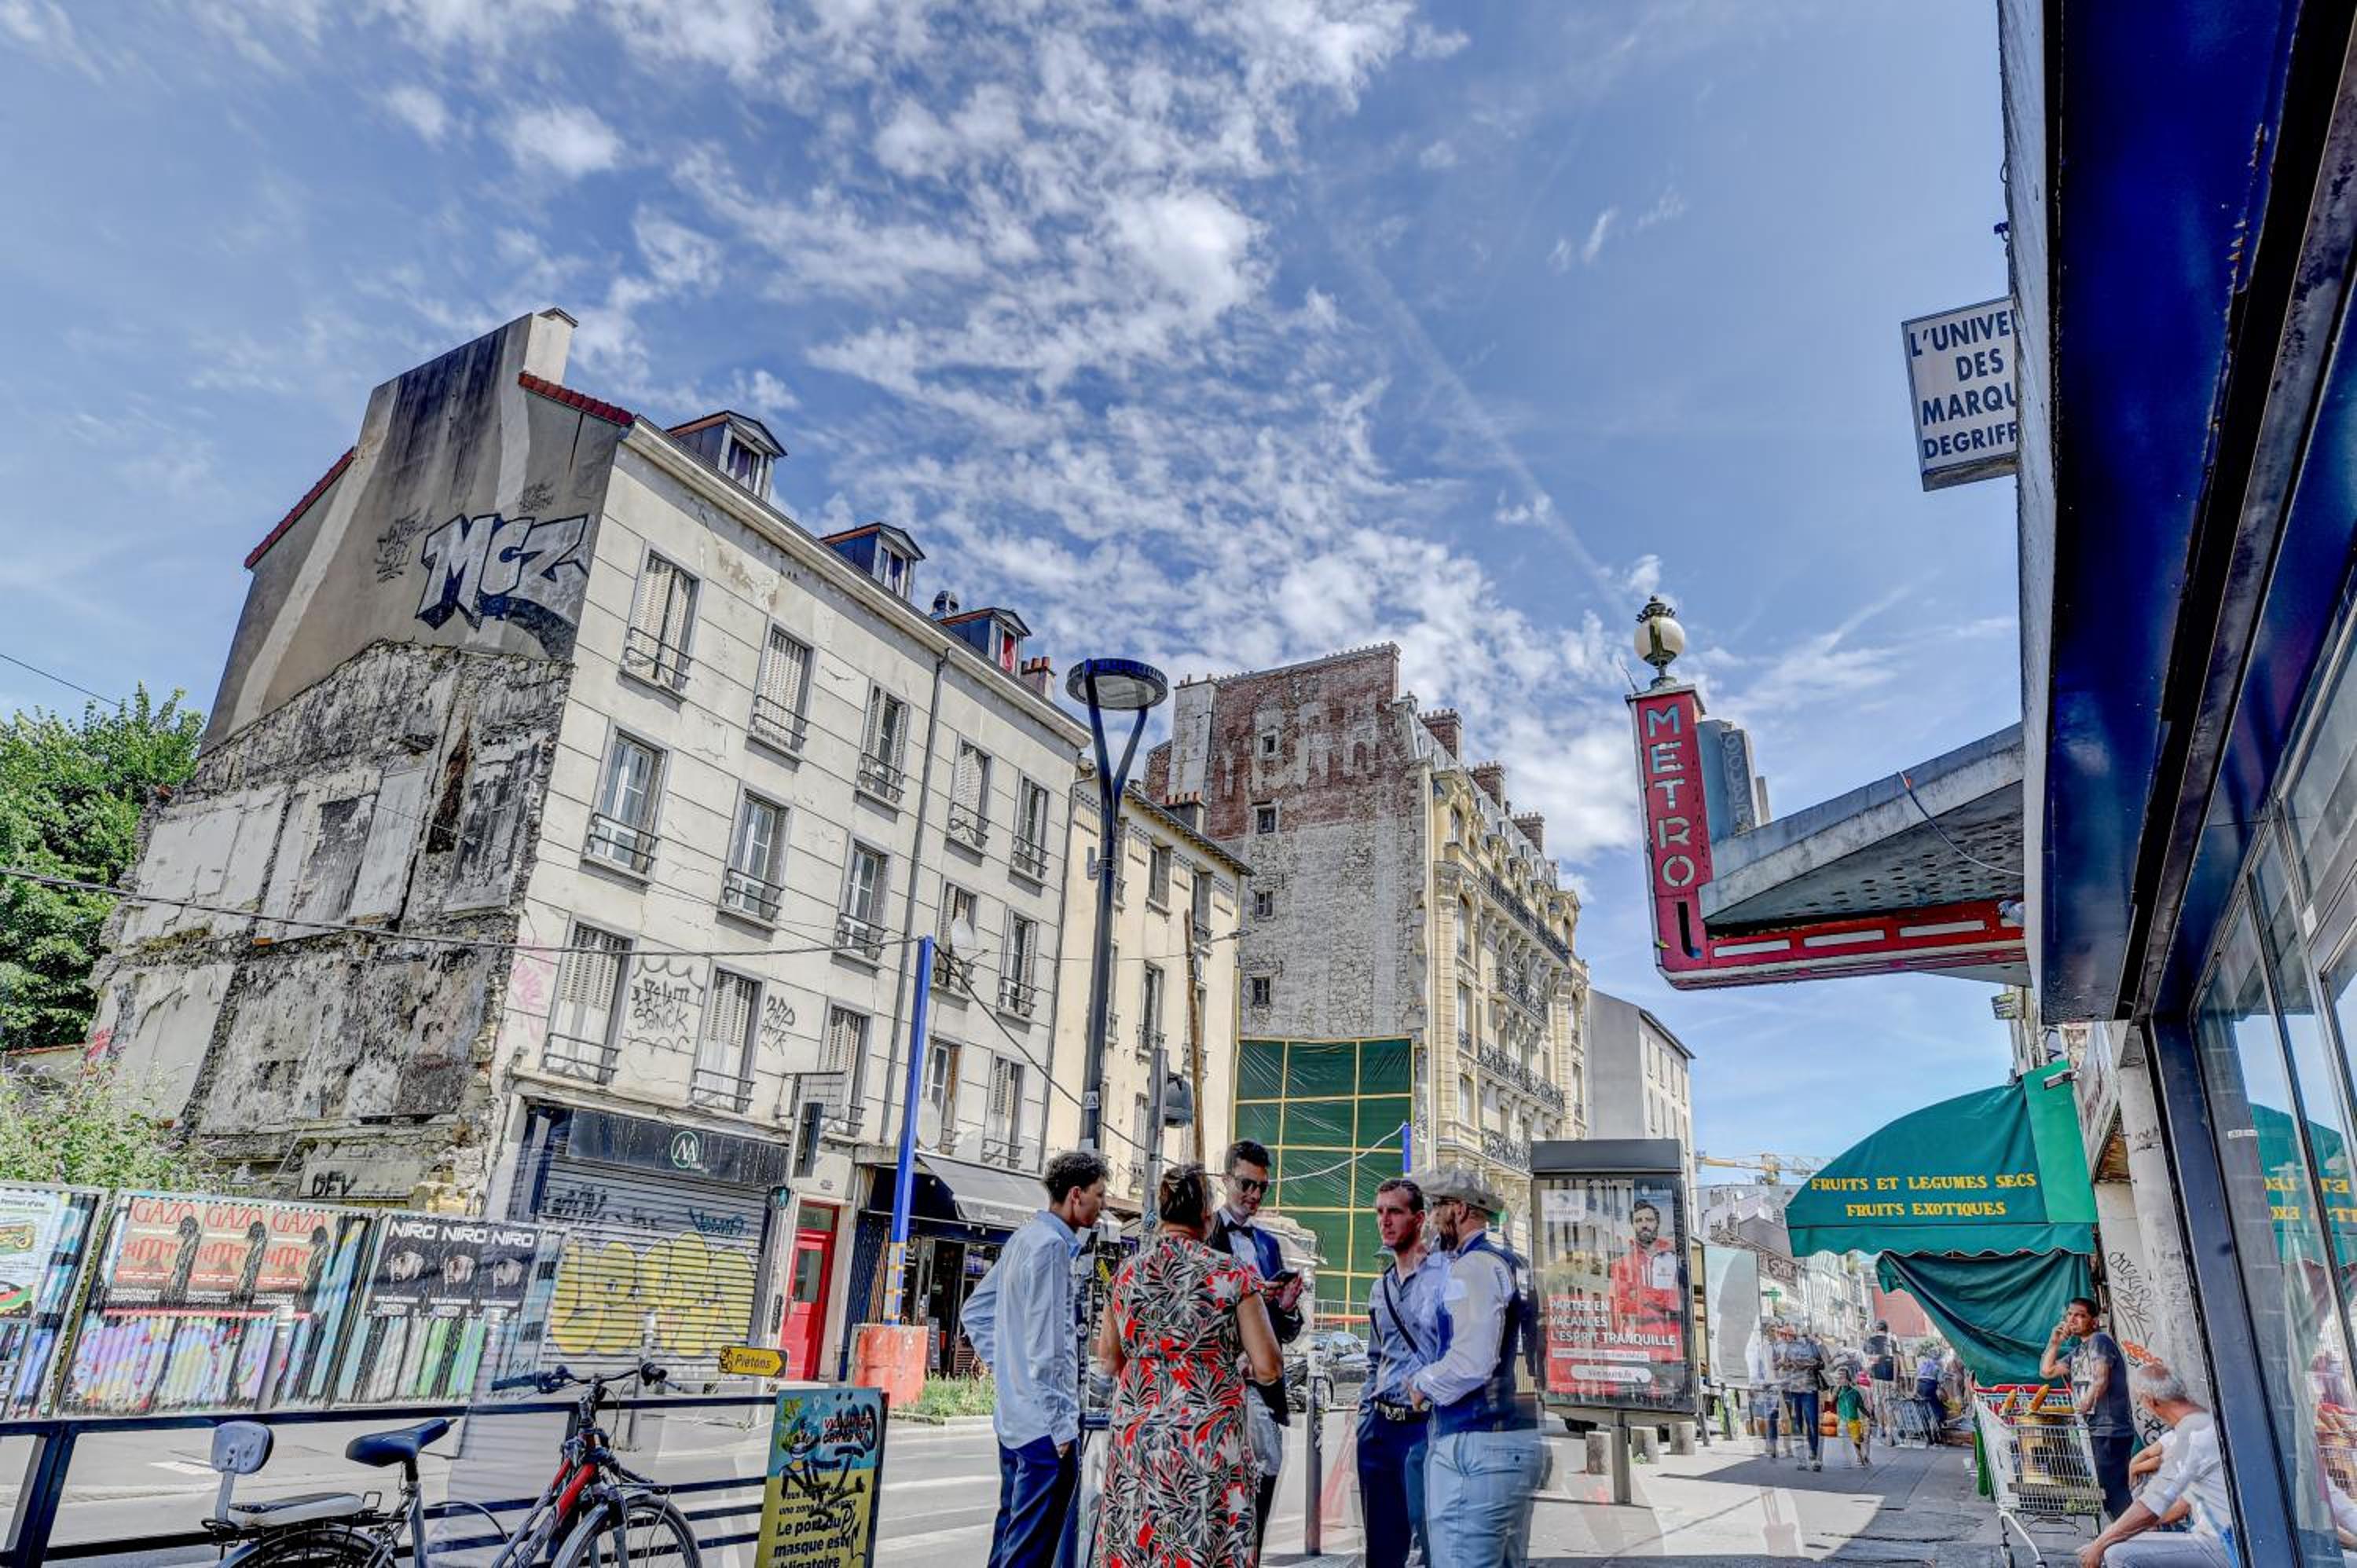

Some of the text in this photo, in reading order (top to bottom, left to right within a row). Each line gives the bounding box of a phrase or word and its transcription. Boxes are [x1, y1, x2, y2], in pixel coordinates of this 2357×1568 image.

[1956, 348, 2003, 381] DES
[1646, 704, 1695, 887] METRO
[1810, 1177, 1869, 1191] FRUITS
[1876, 1176, 1898, 1190] ET
[1996, 1172, 2037, 1188] SECS
[1846, 1201, 2007, 1217] FRUITS EXOTIQUES
[390, 1222, 438, 1240] NIRO
[442, 1226, 488, 1244] NIRO
[491, 1231, 535, 1247] NIRO
[1600, 1332, 1677, 1346] TRANQUILLE
[777, 1521, 793, 1537] Le
[774, 1539, 823, 1558] masque
